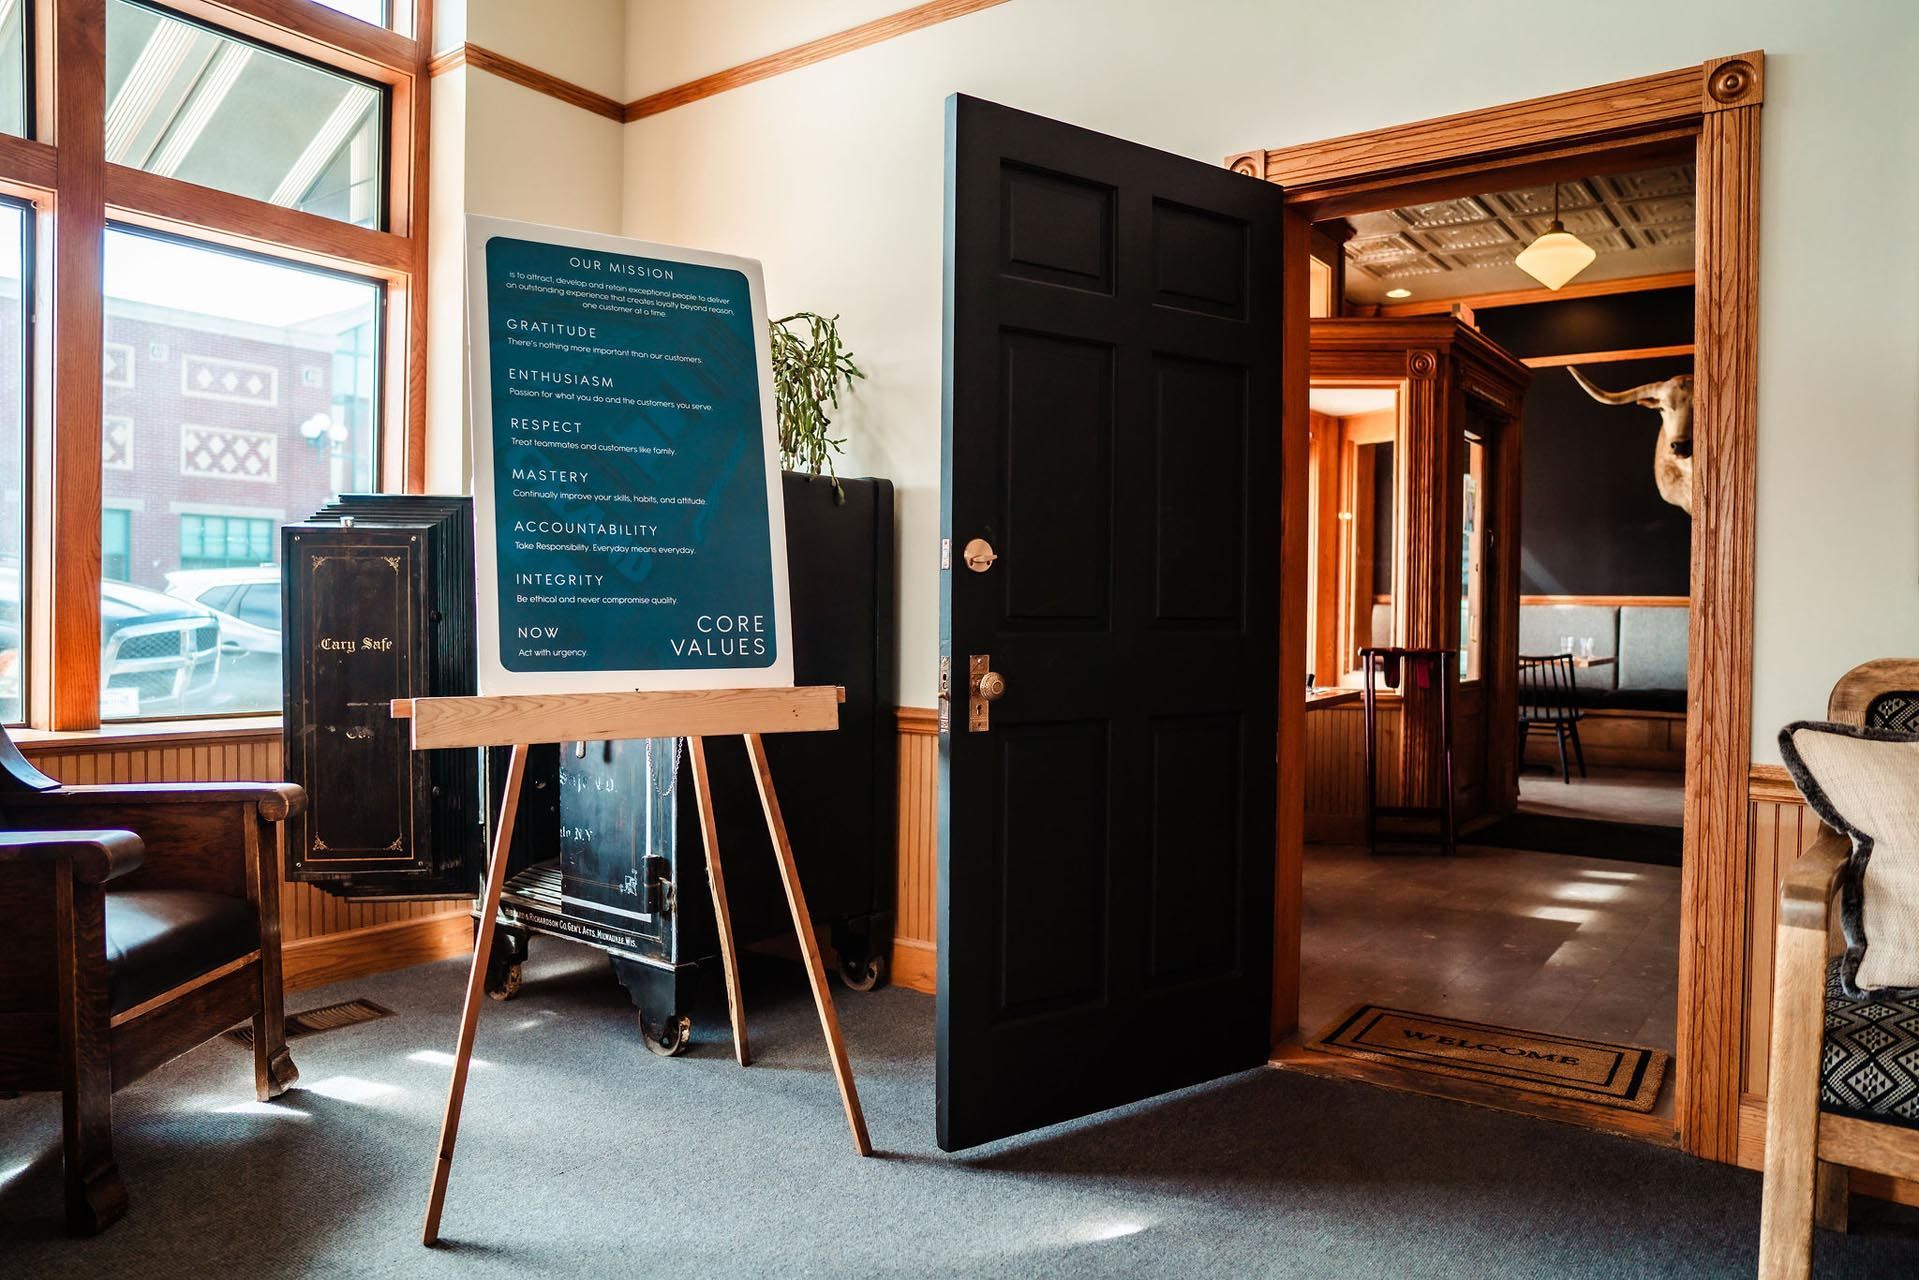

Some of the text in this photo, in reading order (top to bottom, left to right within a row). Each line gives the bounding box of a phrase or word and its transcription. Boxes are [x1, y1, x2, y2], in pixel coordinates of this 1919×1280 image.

[569, 257, 673, 280] OUR MISSION
[526, 273, 554, 284] attract,
[555, 277, 587, 288] develop
[605, 284, 628, 292] retain
[628, 287, 671, 297] exceptional
[671, 292, 697, 301] people
[706, 296, 730, 305] deliver
[518, 283, 565, 296] outstanding
[565, 289, 609, 301] experience
[610, 294, 626, 302] that
[626, 297, 655, 306] creates
[655, 299, 679, 309] loyalty
[679, 302, 708, 312] beyond
[708, 307, 734, 316] reason,
[582, 302, 598, 310] one
[598, 304, 633, 313] customer
[650, 309, 667, 317] time.
[506, 318, 596, 338] GRATITUDE
[507, 336, 538, 347] There's
[538, 342, 569, 352] nothing
[570, 345, 591, 353] more
[592, 347, 630, 356] important
[630, 350, 649, 358] than
[663, 354, 703, 364] customers.
[509, 368, 613, 388] ENTHUSIASM
[509, 387, 540, 397] Passion
[541, 390, 553, 398] for
[554, 392, 575, 400] what
[575, 394, 591, 402] you
[592, 395, 604, 403] do
[604, 396, 621, 404] and
[622, 397, 636, 405] the
[636, 399, 675, 408] customers
[691, 403, 713, 411] serve.
[510, 417, 581, 433] RESPECT
[511, 437, 532, 446] Treat
[533, 439, 579, 449] teammates
[597, 444, 638, 453] customers
[638, 446, 652, 454] like
[652, 446, 676, 456] family.
[512, 468, 588, 483] MASTERY
[512, 488, 558, 500] Continually
[559, 491, 593, 500] improve
[593, 494, 612, 502] your
[613, 494, 632, 502] skills,
[633, 495, 659, 504] habits,
[676, 496, 707, 505] attitude.
[514, 520, 657, 536] ACCOUNTABILITY
[514, 541, 535, 550] Take
[535, 541, 590, 552] Responsibility.
[592, 543, 630, 553] Everyday
[658, 546, 696, 555] everyday.
[516, 573, 603, 586] INTEGRITY
[516, 594, 678, 605] Be ethical and never compromise quality.
[696, 615, 764, 633] CORE
[518, 627, 559, 639] NOW
[321, 637, 393, 654] Cary Safe
[518, 648, 532, 657] Act
[552, 649, 588, 658] urgency.
[670, 637, 765, 656] VALUES
[1403, 1029, 1581, 1066] WELCOME
